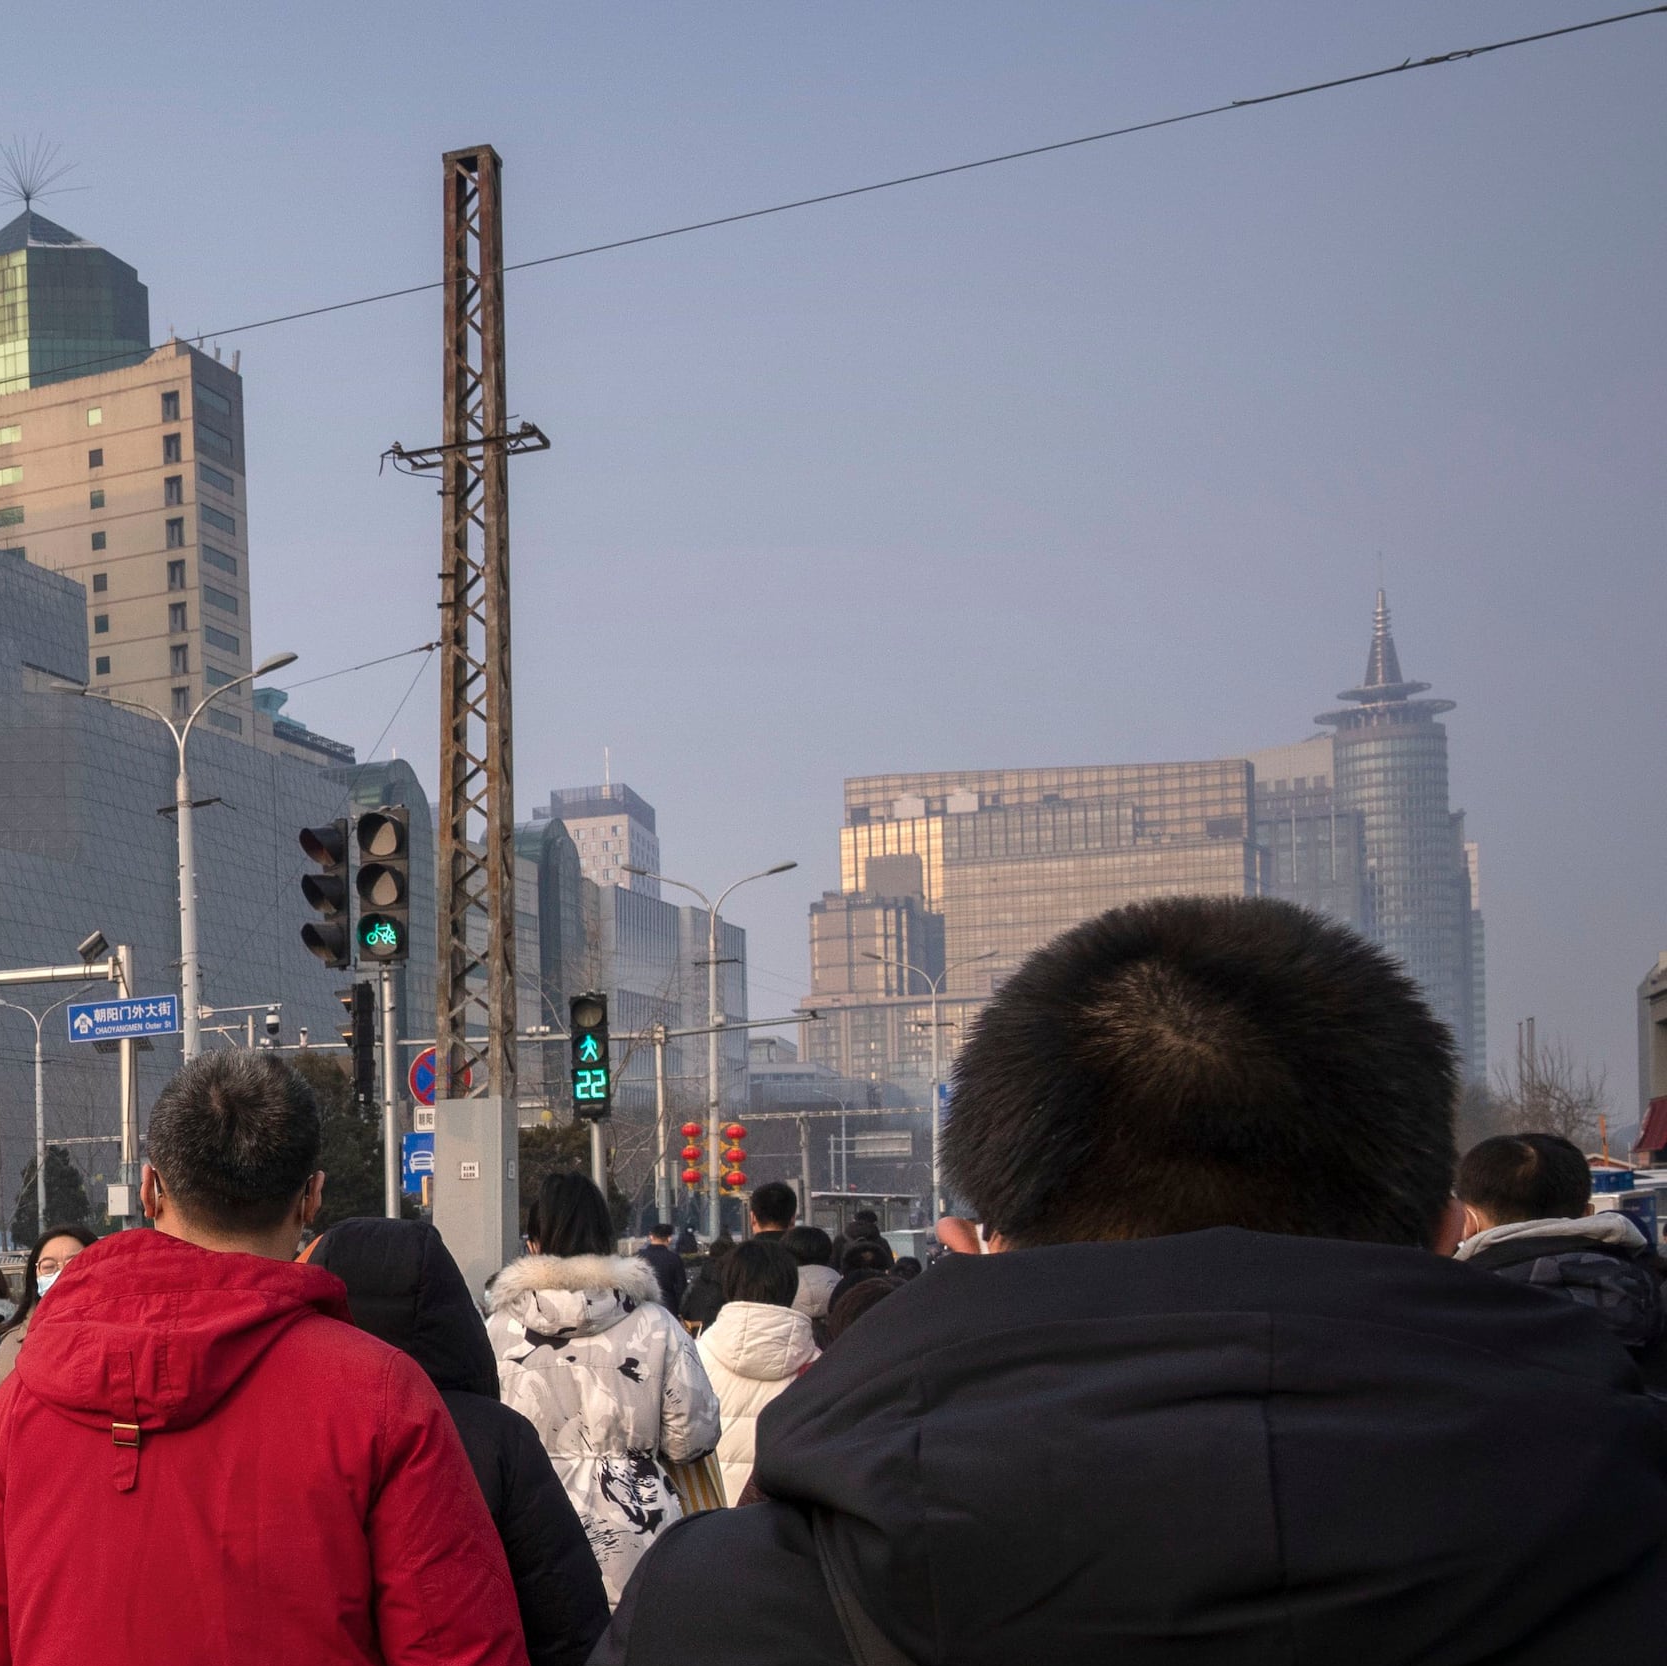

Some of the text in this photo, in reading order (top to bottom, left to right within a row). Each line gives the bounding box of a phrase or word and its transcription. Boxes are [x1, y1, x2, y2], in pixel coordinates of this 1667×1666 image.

[93, 1001, 171, 1023] 朝阳门外大街
[95, 1020, 172, 1035] CHAOYANGMEN Outer St
[576, 1069, 606, 1099] 22
